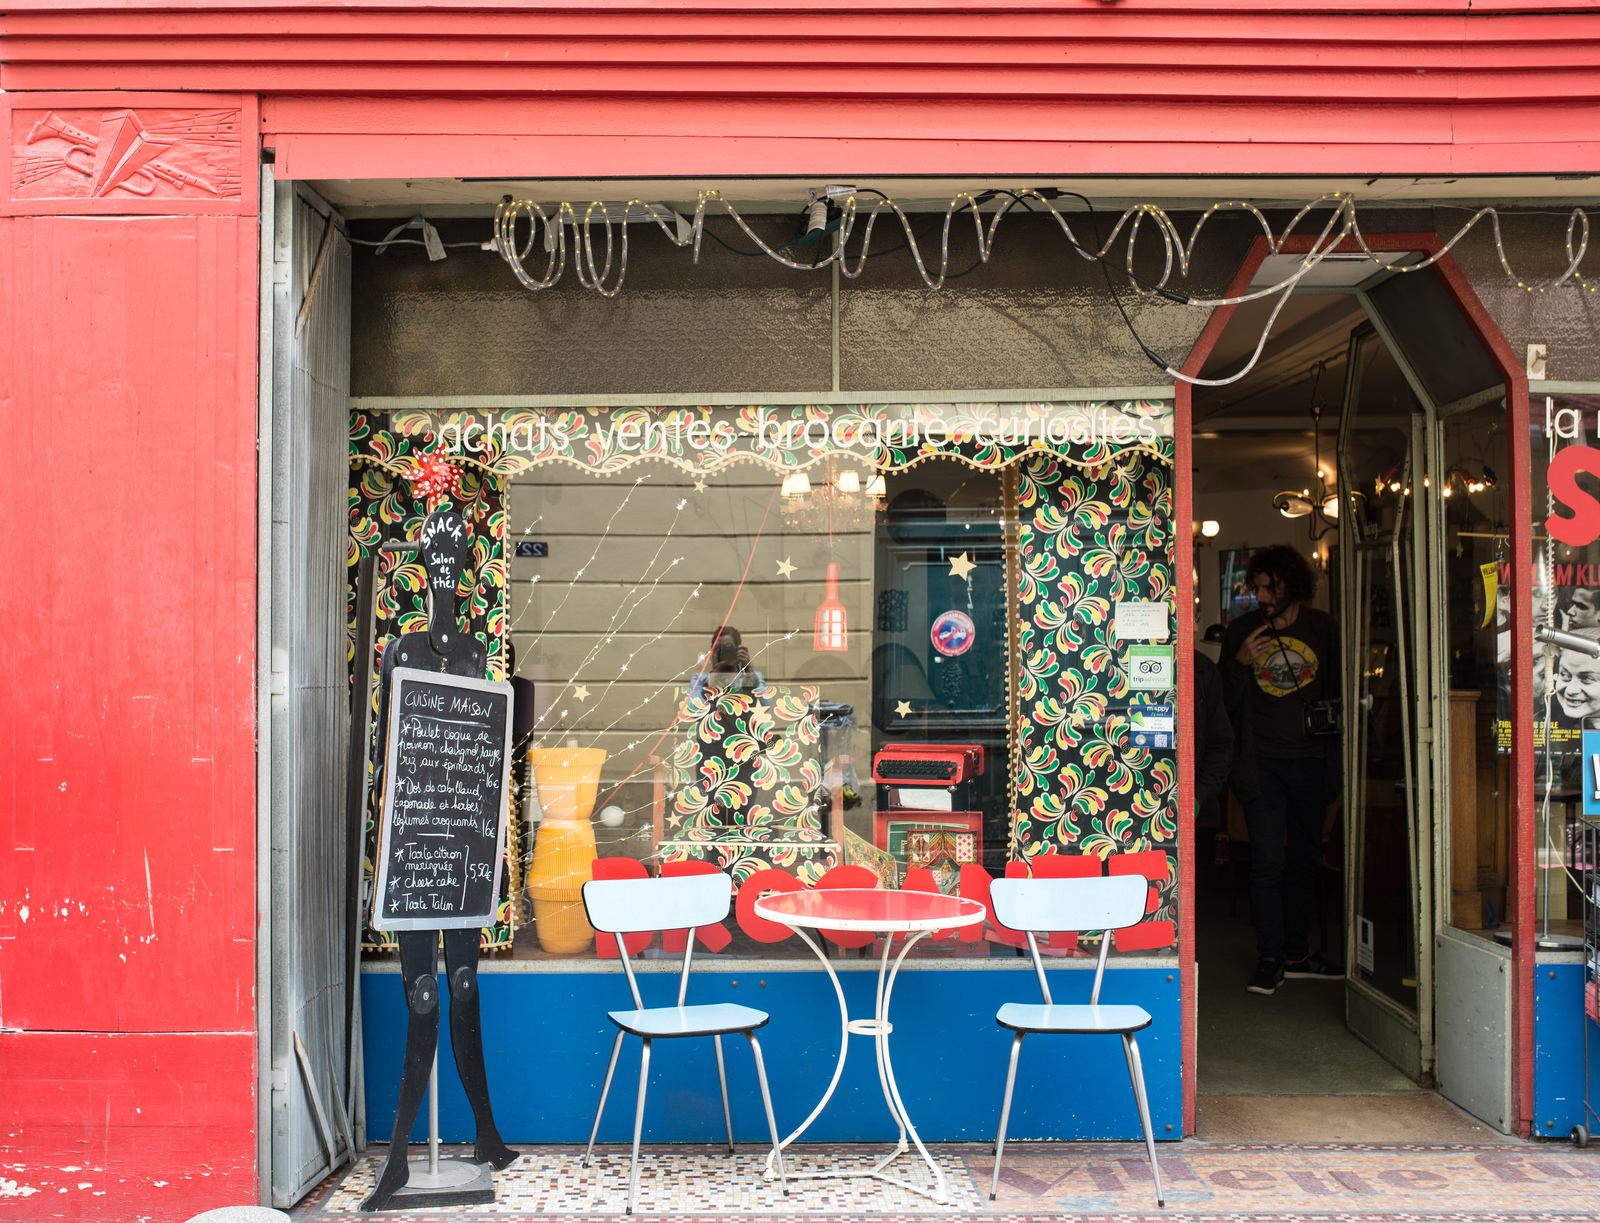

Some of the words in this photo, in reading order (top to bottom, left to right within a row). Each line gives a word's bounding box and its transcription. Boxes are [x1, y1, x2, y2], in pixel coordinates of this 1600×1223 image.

[1545, 396, 1579, 438] la
[438, 413, 570, 452] achats
[595, 412, 732, 450] ventes
[758, 407, 950, 448] brocante
[423, 516, 462, 549] SNACK
[430, 552, 455, 566] Salon
[439, 565, 451, 575] de
[432, 575, 455, 589] thés
[411, 717, 440, 739] Poulet
[474, 731, 493, 744] de
[400, 756, 417, 774] riz
[420, 758, 440, 768] aux
[442, 759, 486, 780] épinards
[406, 776, 421, 795] Dos
[424, 779, 435, 793] de
[439, 800, 449, 810] et
[393, 810, 429, 835] légumes
[404, 842, 433, 860] Tarte
[434, 846, 462, 860] citron
[405, 861, 453, 877] meringuée
[436, 872, 460, 888] cake
[401, 893, 428, 912] Tarte
